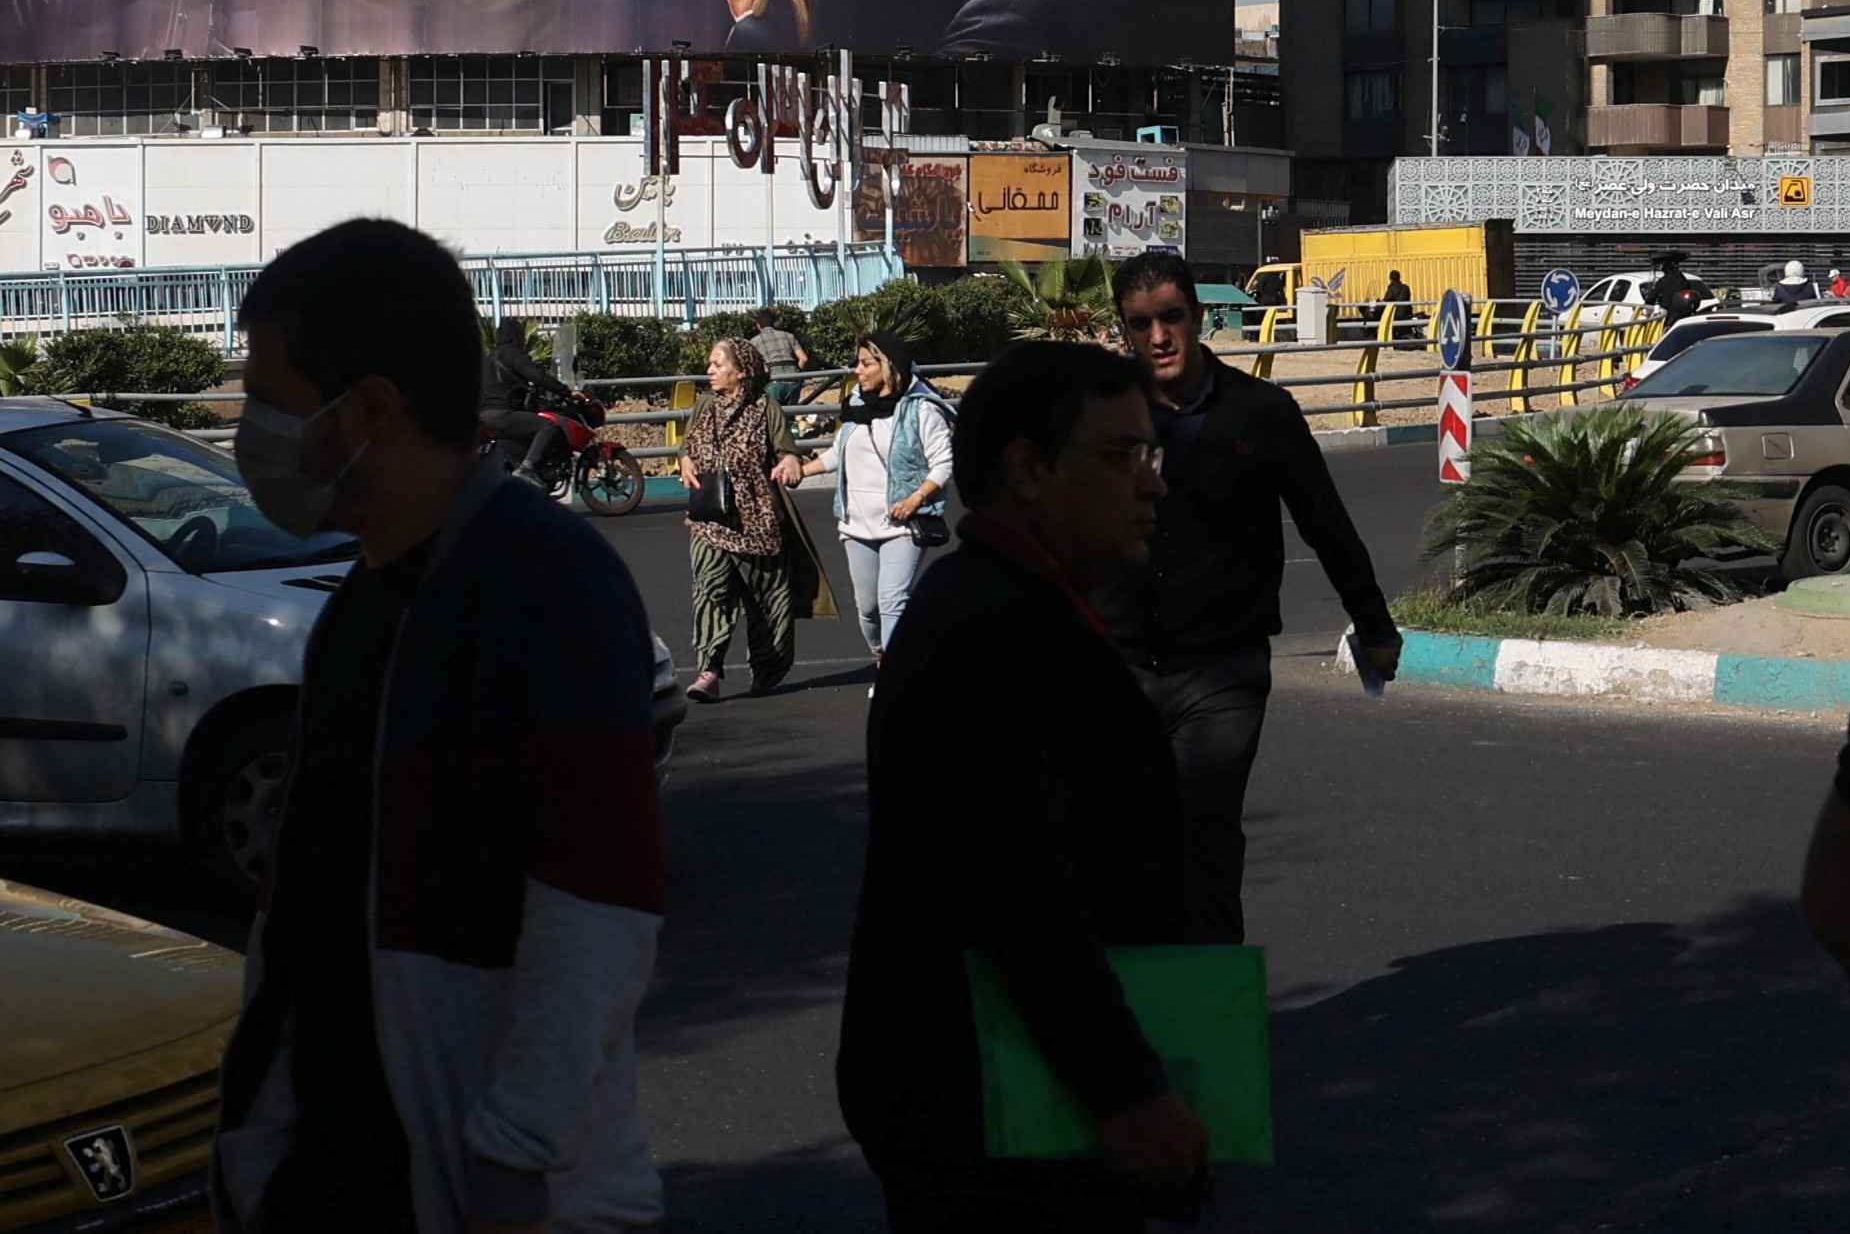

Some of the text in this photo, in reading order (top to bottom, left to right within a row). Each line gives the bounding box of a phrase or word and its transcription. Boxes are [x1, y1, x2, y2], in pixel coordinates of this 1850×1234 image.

[1087, 154, 1181, 187] فست فود
[1594, 179, 1628, 195] عصر
[1632, 177, 1656, 197] ولی
[1661, 177, 1709, 193] حضرت
[1107, 200, 1158, 230] آرام
[1575, 207, 1755, 221] Meydan-e Hazrat-e Vali Asr
